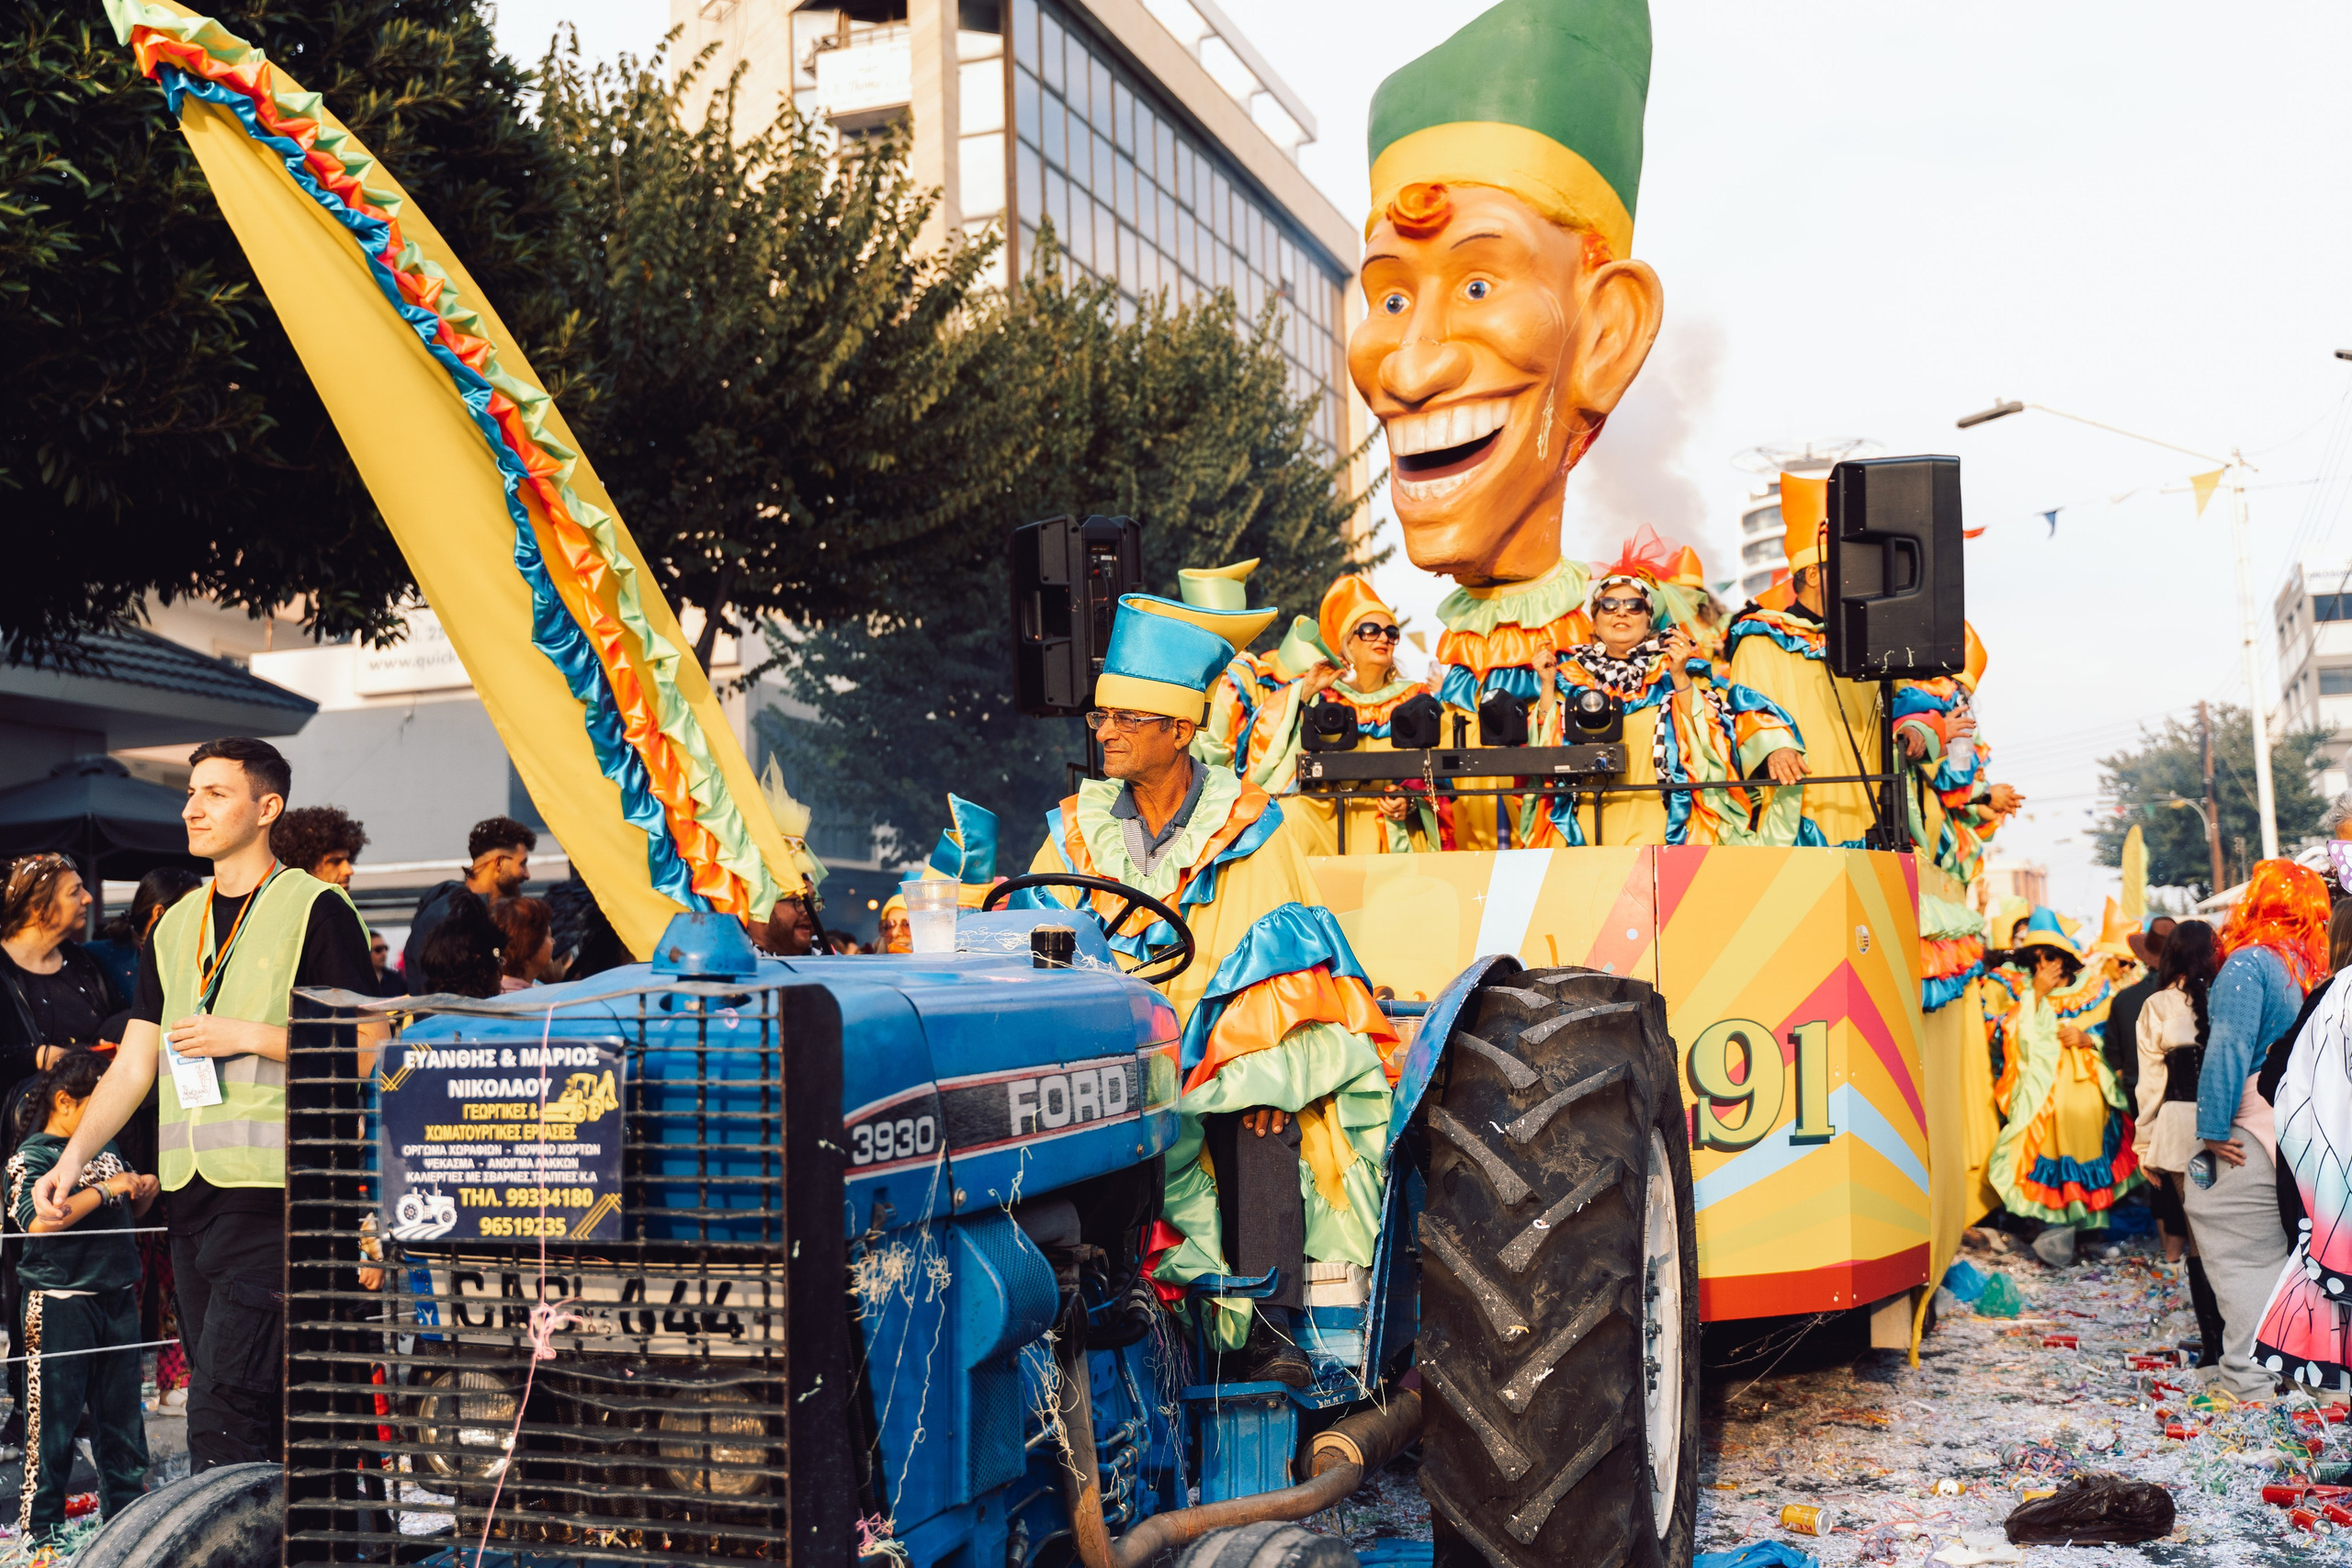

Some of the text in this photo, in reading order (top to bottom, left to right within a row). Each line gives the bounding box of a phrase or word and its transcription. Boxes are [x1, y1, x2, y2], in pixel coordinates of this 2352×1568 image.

[369, 649, 458, 671] www.quick
[403, 1047, 600, 1069] ΕΥΑΝΘΗΣ & ΜΑΡΙΟΣ
[447, 1077, 553, 1099] ΝΙΚΟΛΑΟΥ
[1686, 1018, 1837, 1153] 91
[1007, 1065, 1128, 1137] FORD
[462, 1103, 539, 1121] ΓΕΩΡΓΙΚΕΣ &
[424, 1124, 522, 1142] ΧΩΜΑΤΟΥΡΓΙΚΕΣ
[852, 1115, 936, 1166] 3930
[401, 1145, 447, 1156] ΟΡΓΩΜΑ
[557, 1144, 601, 1156] ΧΟΡΤΩΝ
[423, 1157, 475, 1169] ΨΕΚΑΣΜΑ
[464, 1171, 482, 1182] ΜΕ
[458, 1188, 594, 1208] ΤΗΛ. 99334180
[479, 1216, 567, 1237] 96519235
